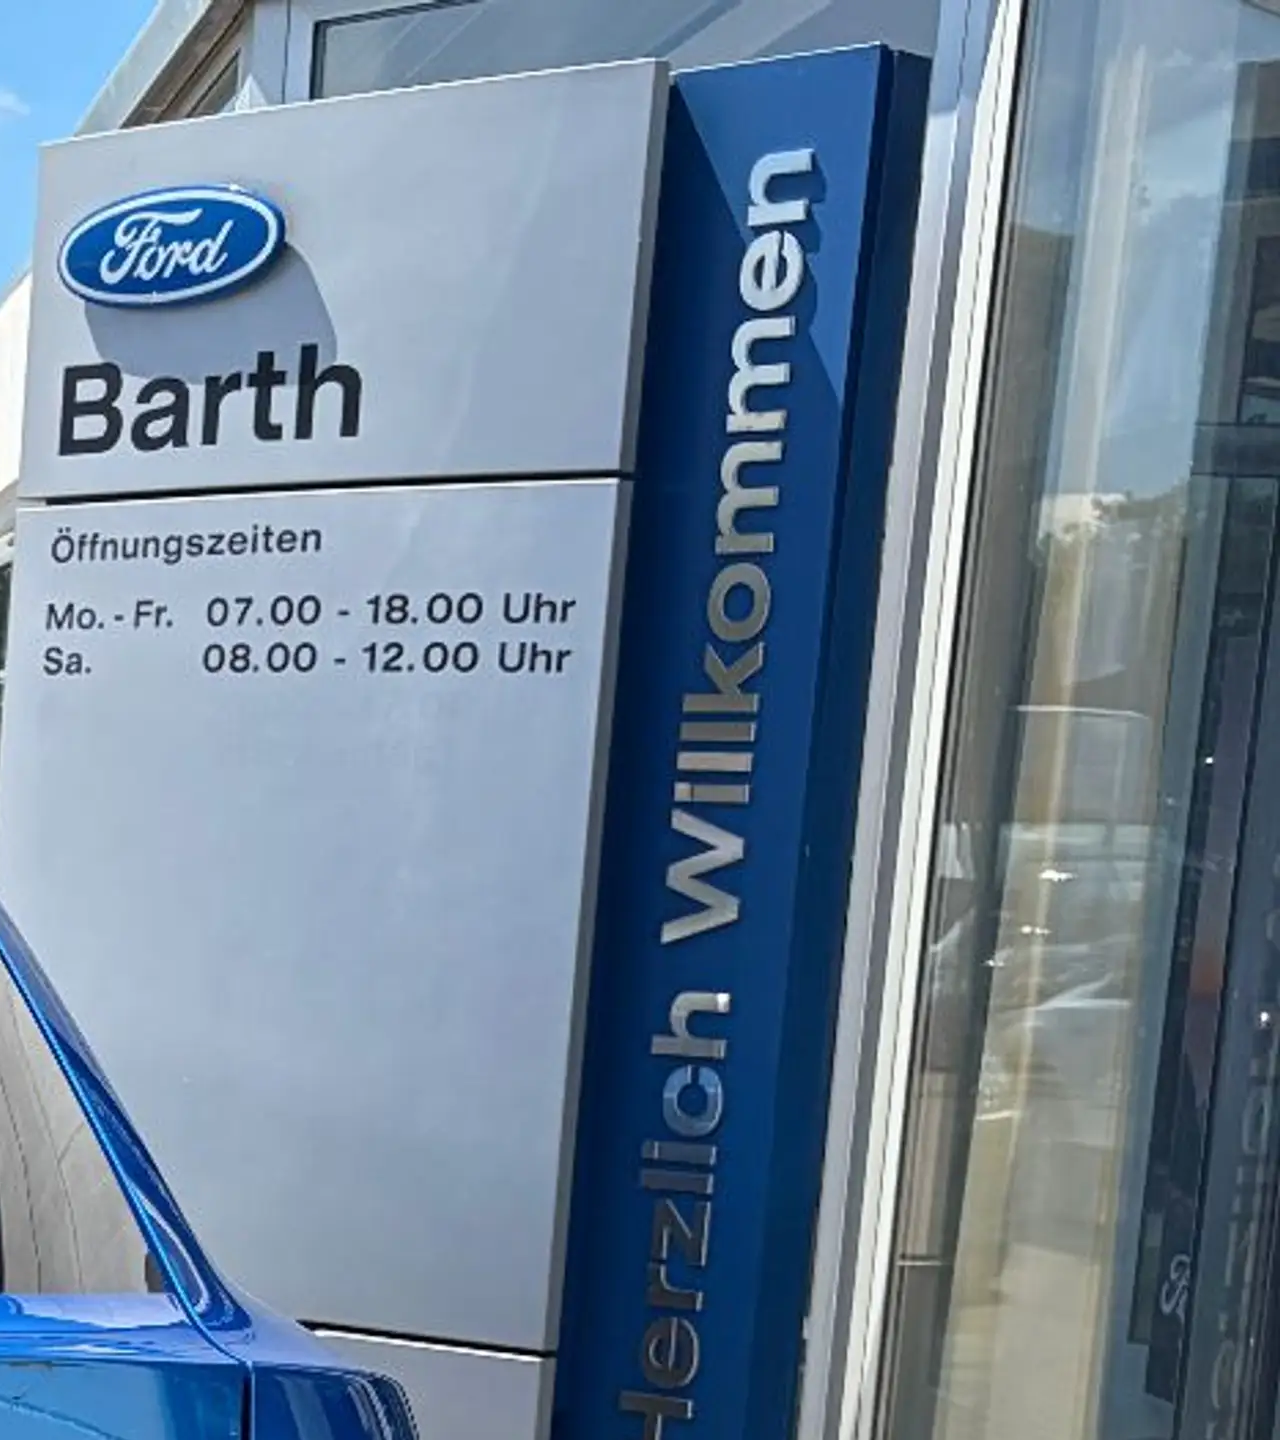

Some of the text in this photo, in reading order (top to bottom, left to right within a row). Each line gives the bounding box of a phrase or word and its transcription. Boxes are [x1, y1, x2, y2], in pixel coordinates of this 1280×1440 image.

[99, 207, 235, 285] Ford
[58, 343, 362, 457] Barth
[50, 524, 323, 565] Öffnungszeiten
[660, 146, 817, 945] Willkommen
[45, 602, 105, 631] Mo.
[133, 600, 174, 628] Fr.
[206, 595, 322, 627] 07.00
[366, 592, 484, 625] 18.00
[502, 592, 577, 625] Uhr
[42, 646, 92, 676] Sa.
[202, 641, 318, 674] 08.00
[362, 641, 479, 674] 12.00
[498, 641, 573, 674] Uhr
